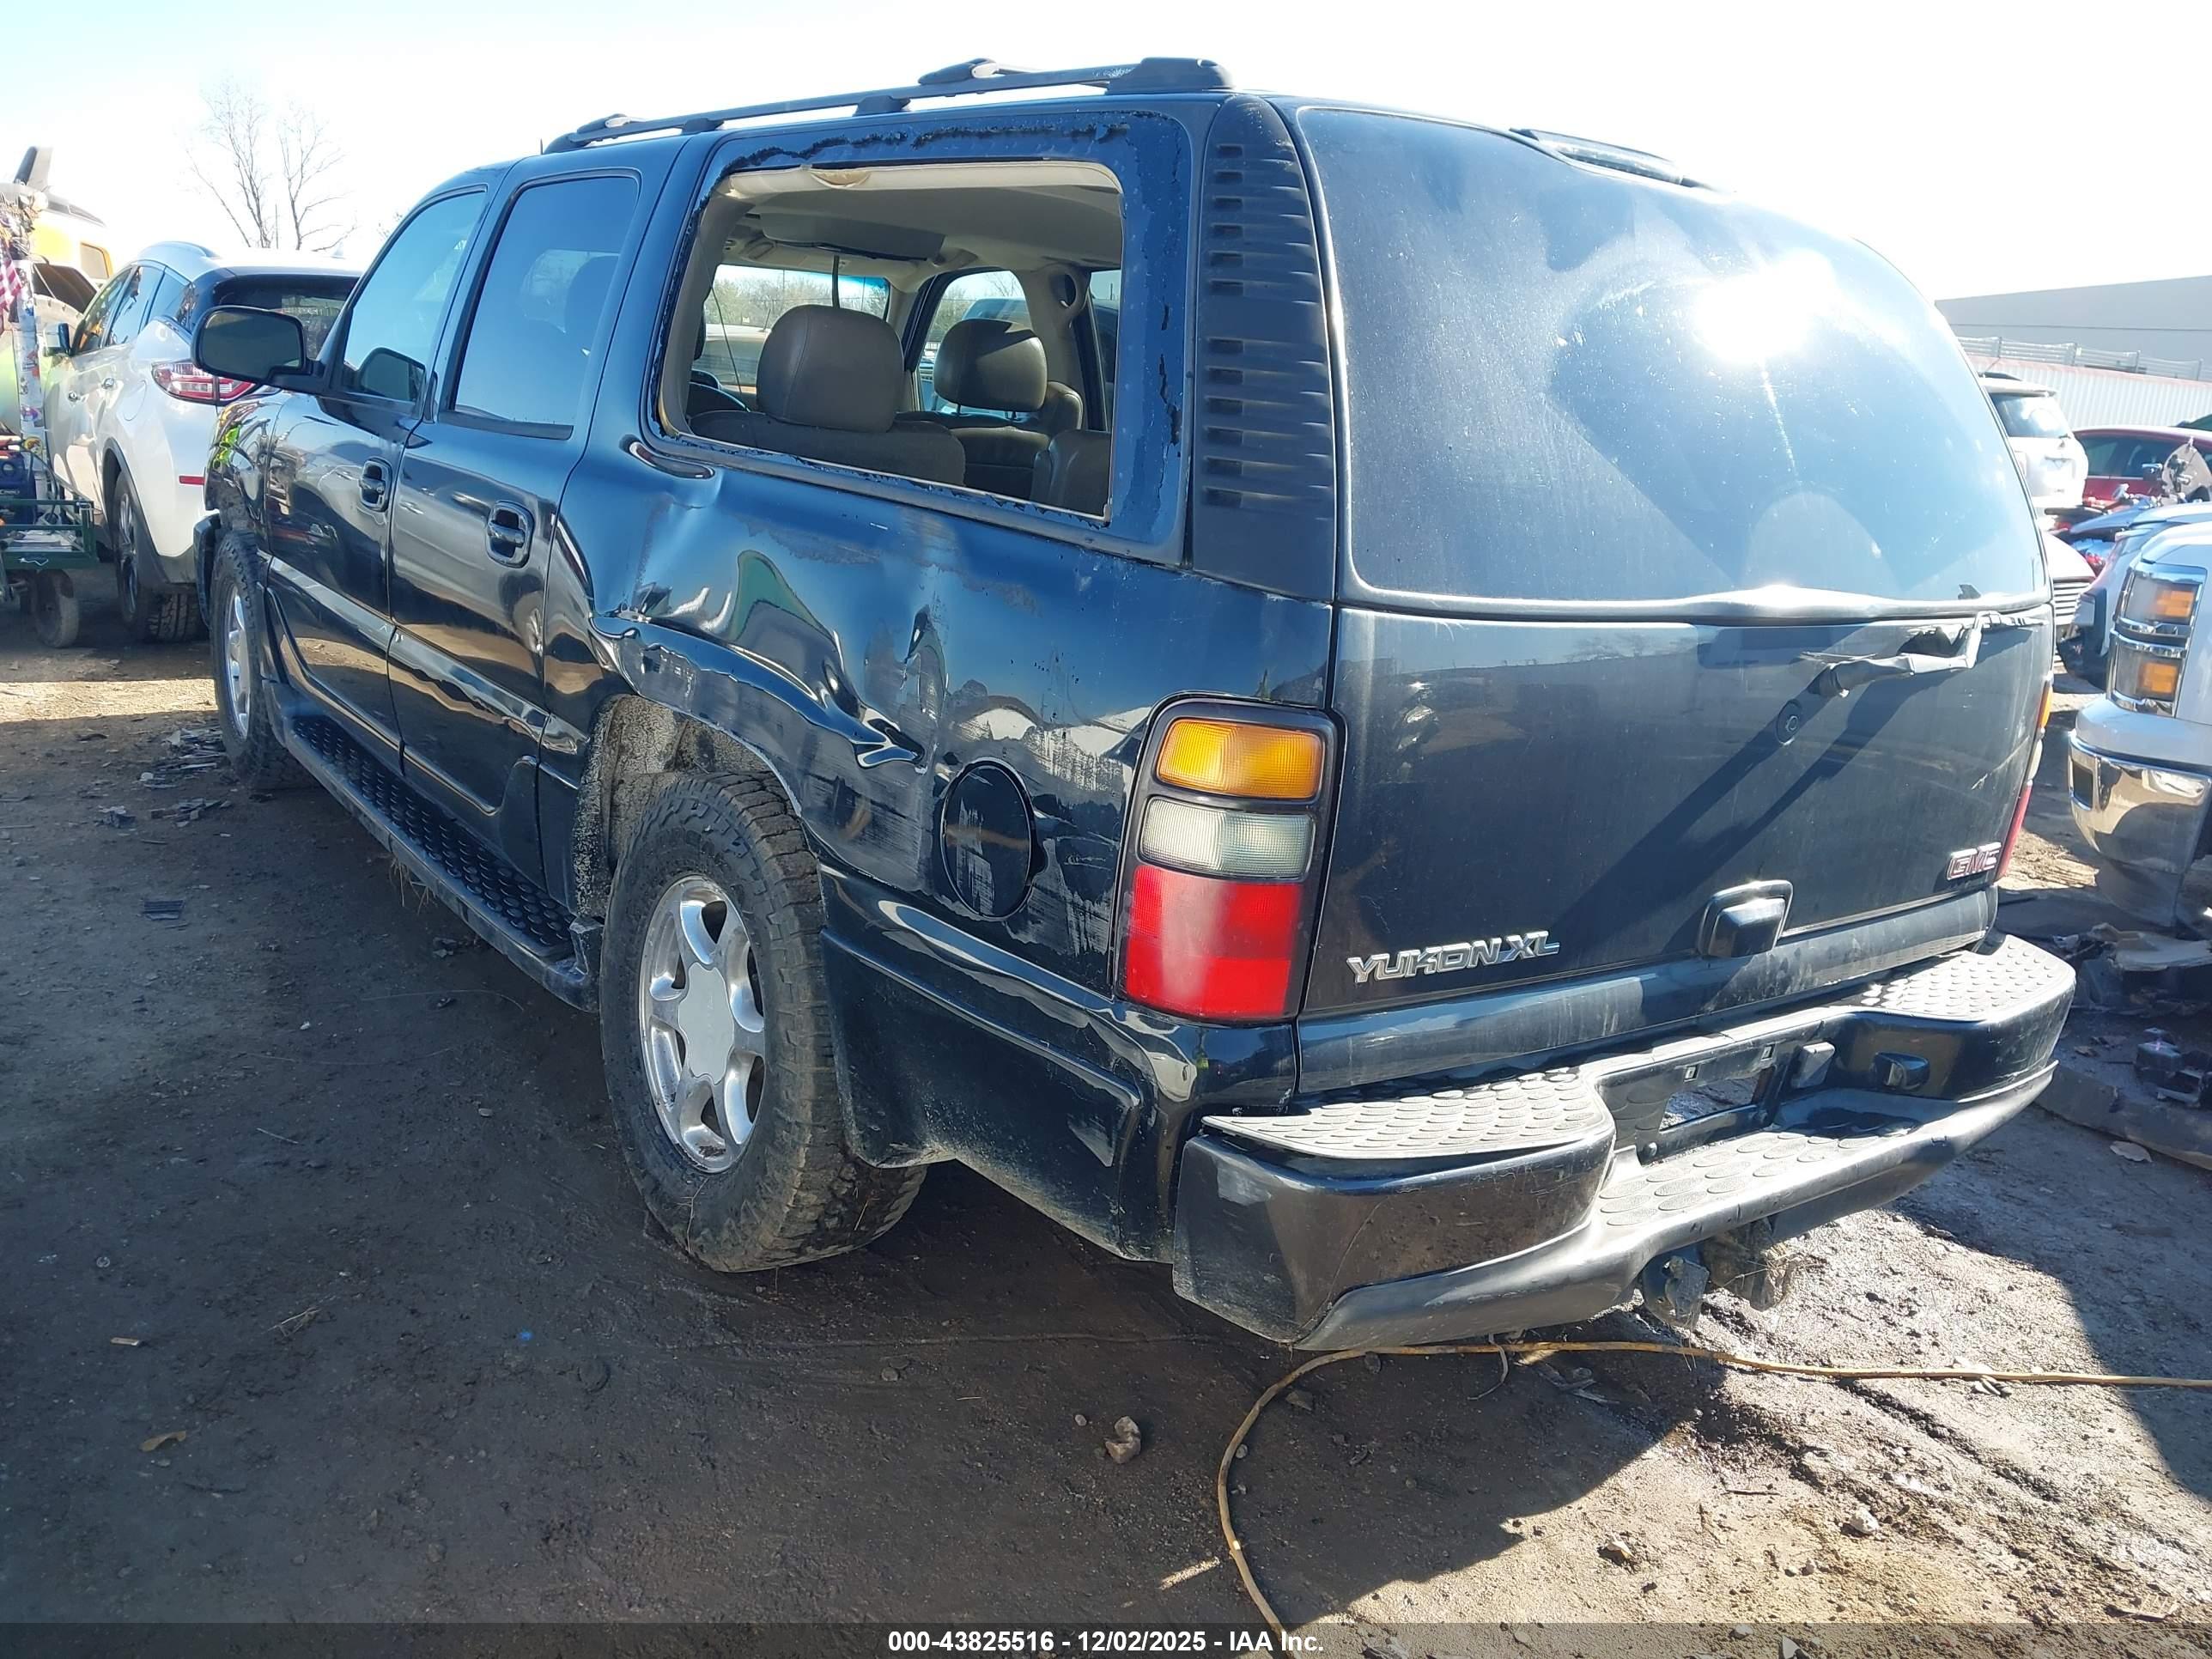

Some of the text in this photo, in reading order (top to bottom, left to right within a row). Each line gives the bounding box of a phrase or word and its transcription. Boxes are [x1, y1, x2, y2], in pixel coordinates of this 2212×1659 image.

[1947, 842, 2002, 881] GMC
[1346, 930, 1560, 983] YUKON XL
